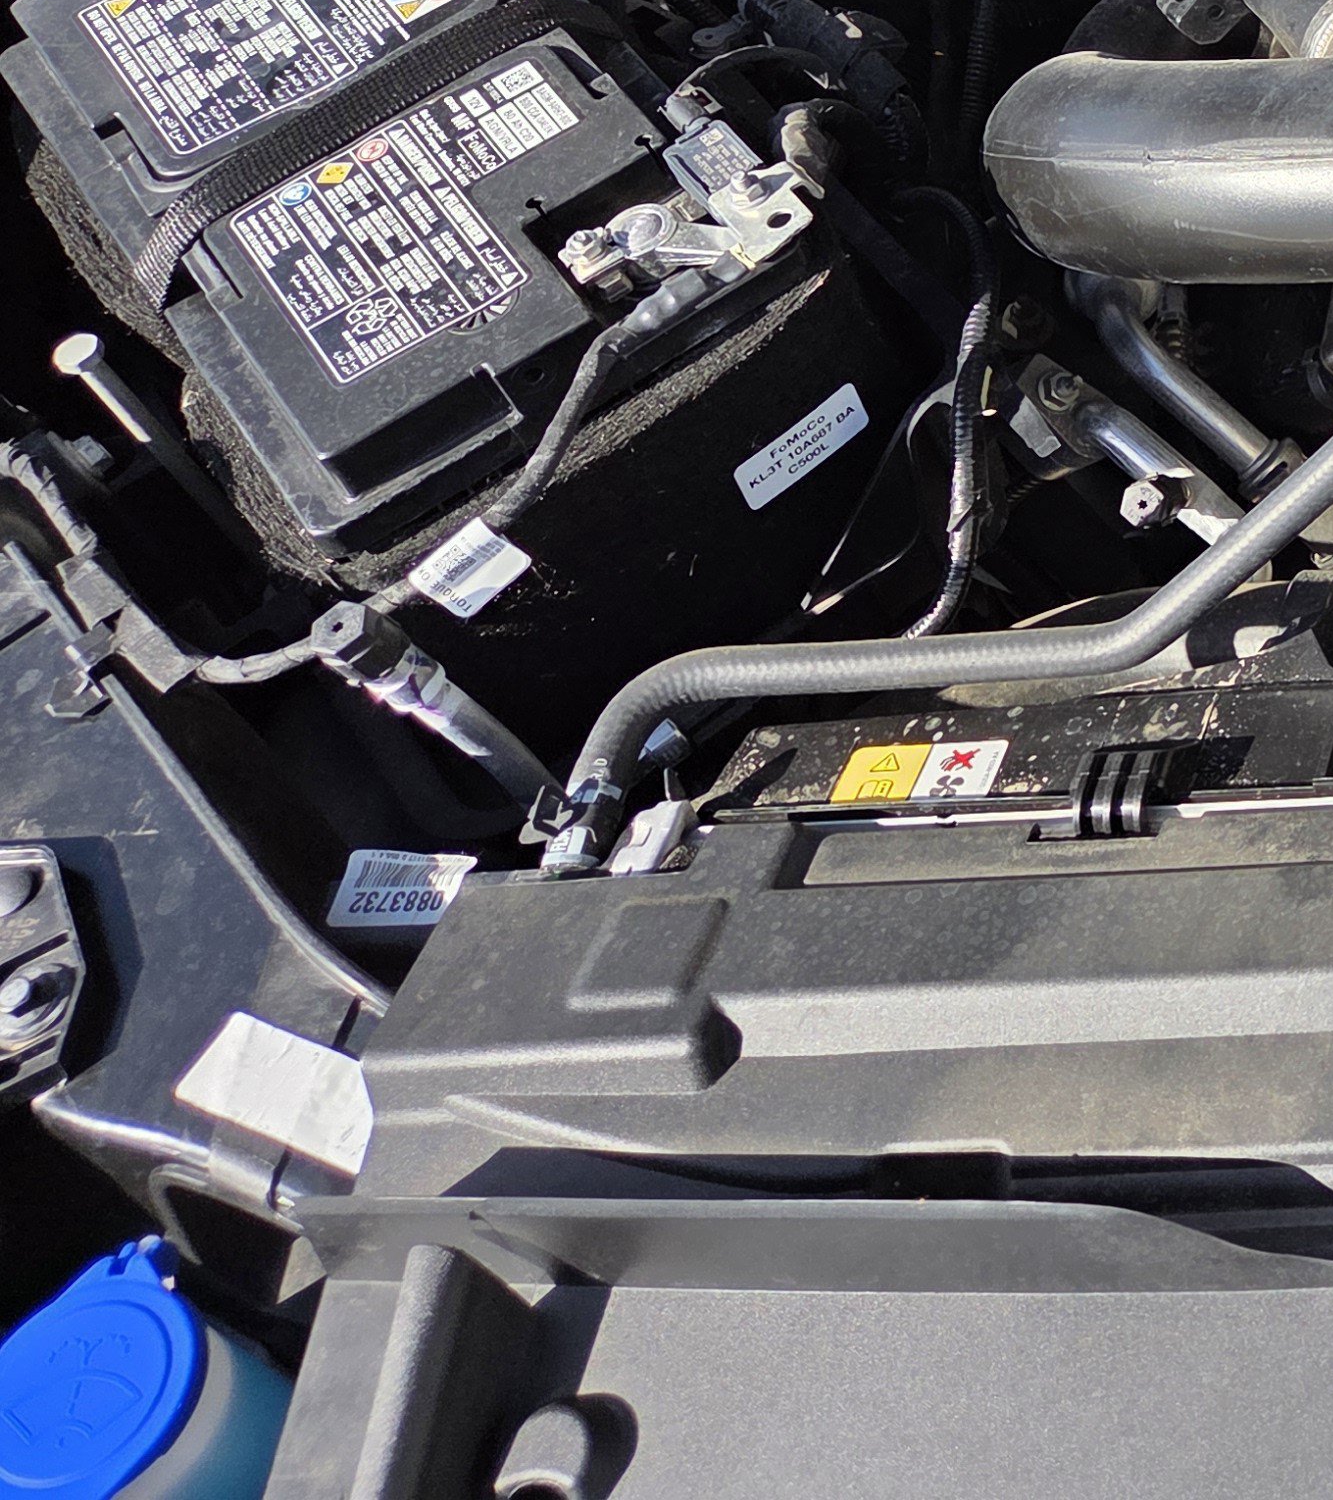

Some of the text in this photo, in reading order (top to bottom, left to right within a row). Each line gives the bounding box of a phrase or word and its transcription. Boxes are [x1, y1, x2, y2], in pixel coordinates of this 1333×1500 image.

[465, 95, 483, 110] 12V
[449, 111, 475, 133] MF
[462, 132, 500, 171] FoMoCo
[749, 406, 855, 489] KL3T 10A687 BA
[769, 415, 826, 459] FoMoCo
[788, 444, 830, 475] C500L
[349, 891, 445, 913] 0883732
